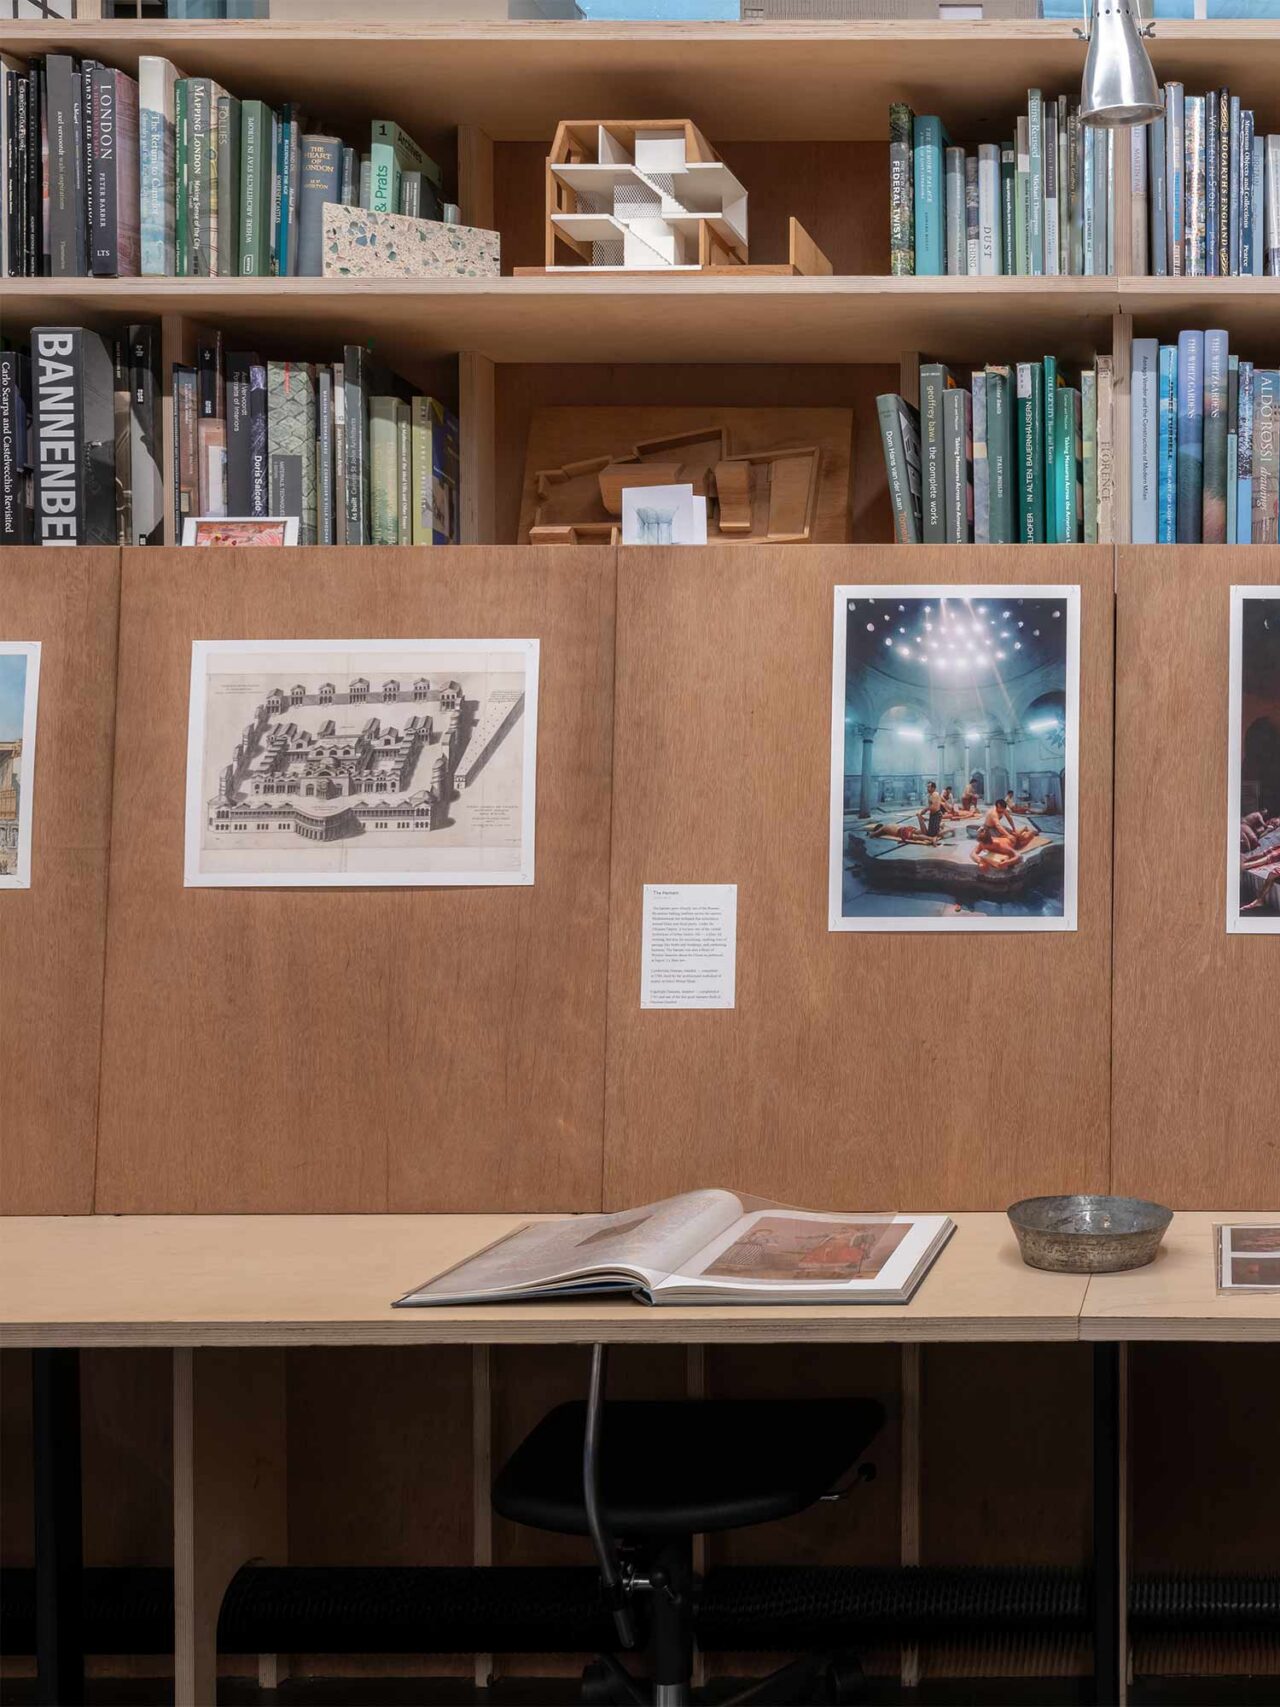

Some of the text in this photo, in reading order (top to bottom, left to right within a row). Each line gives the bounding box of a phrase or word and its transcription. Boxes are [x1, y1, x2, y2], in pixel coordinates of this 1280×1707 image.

[57, 111, 65, 125] axel
[100, 84, 112, 160] LONDON
[151, 114, 160, 131] The
[194, 84, 205, 131] MAPPING
[57, 125, 65, 156] vervoordt
[218, 105, 228, 145] FOLLIES
[247, 116, 255, 144] EUROPE
[379, 123, 388, 136] 1
[1031, 95, 1041, 158] Ruins Reused
[151, 134, 161, 164] Return
[194, 133, 205, 175] LONDON
[247, 145, 254, 154] IN
[304, 152, 332, 160] HEART
[1242, 152, 1250, 176] Objects
[151, 166, 160, 175] to
[192, 180, 201, 201] Making
[246, 174, 254, 217] ARCHITECTS
[374, 165, 388, 212] & Prats
[892, 160, 901, 240] FEDERAL TWIST
[1208, 181, 1217, 213] STONE
[193, 202, 201, 219] Sense
[1031, 174, 1040, 236] Michael Thompson
[192, 238, 201, 250] City
[245, 218, 253, 243] WHERE
[983, 226, 992, 259] DUST
[1187, 337, 1196, 419] THE WIRTZ GARDENS
[1210, 337, 1220, 419] THE WIRTZ GARDENS
[1260, 375, 1273, 418] ALDO
[1, 361, 14, 533] Carlo Scarpa and Castelvecchio Revisited
[885, 430, 894, 448] Dom
[1260, 421, 1273, 462] ROSSI
[887, 448, 896, 466] Hans
[926, 385, 938, 526] geoffrey bawa the complete works
[254, 455, 263, 512] Doris Salcedo
[890, 467, 898, 480] van
[892, 480, 901, 492] der
[1257, 467, 1271, 511] drawings
[894, 493, 903, 511] Laan
[1026, 494, 1033, 503] IN
